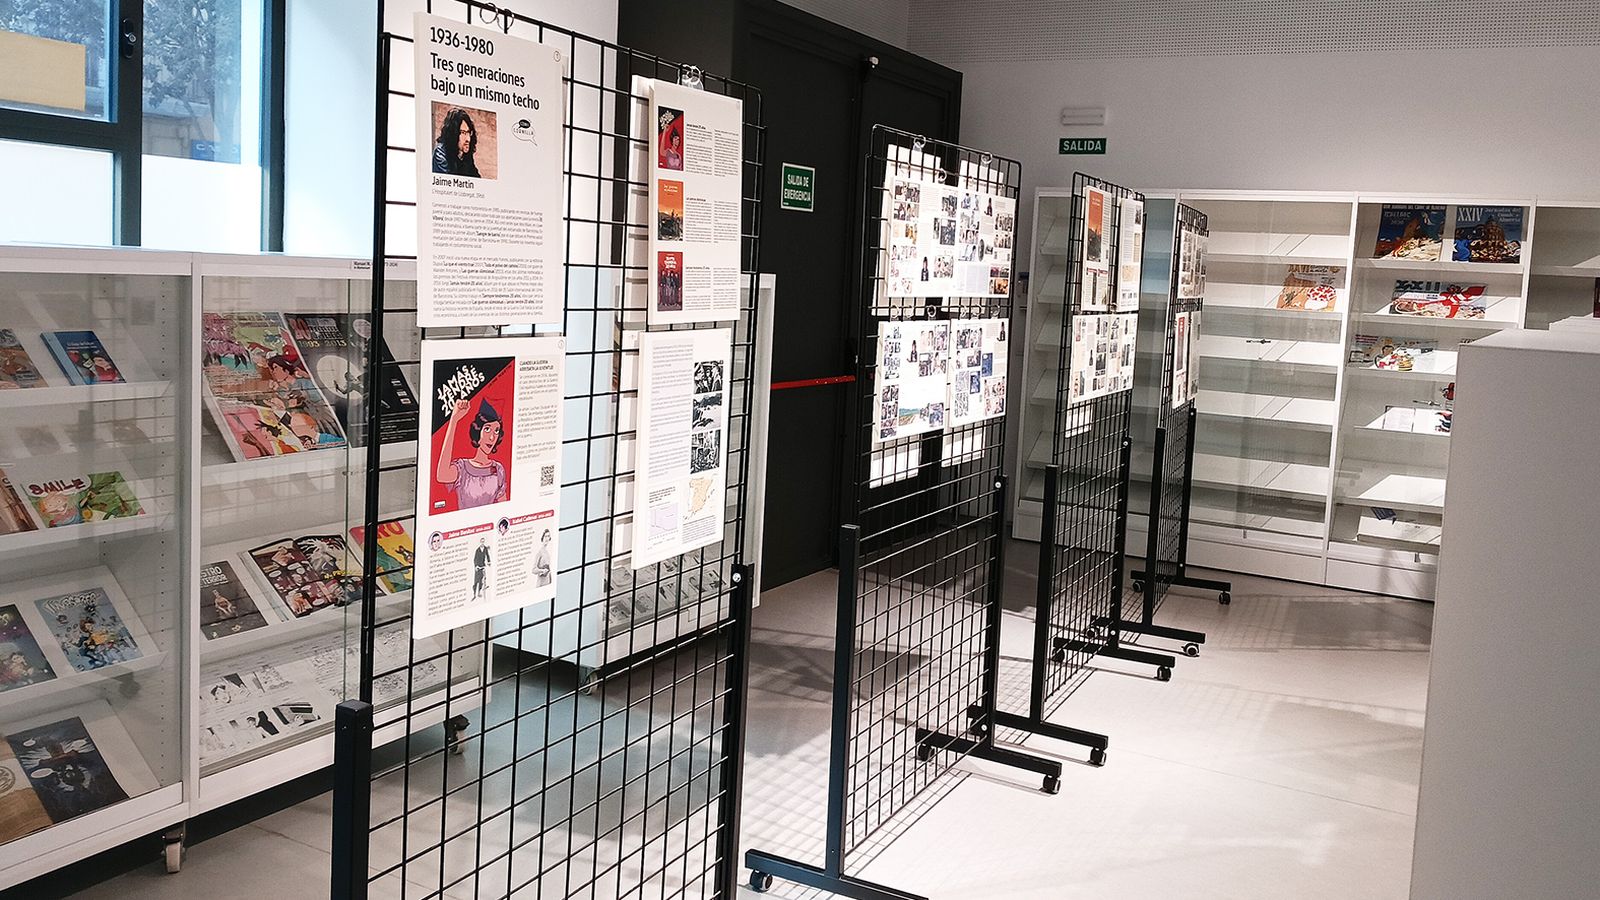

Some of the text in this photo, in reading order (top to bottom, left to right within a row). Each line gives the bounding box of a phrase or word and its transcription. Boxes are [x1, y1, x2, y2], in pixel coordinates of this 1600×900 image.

[430, 26, 494, 56] 1936-1980
[430, 52, 525, 88] Tres generaciones
[430, 74, 540, 111] bajo un mismo techo
[1063, 140, 1102, 151] SALIDA
[432, 176, 452, 187] Jaime
[787, 174, 810, 187] SALIDA DE
[784, 188, 811, 201] EMERGENCIA
[1457, 207, 1484, 222] XXIV
[441, 399, 456, 418] 20
[29, 478, 87, 496] SMILE
